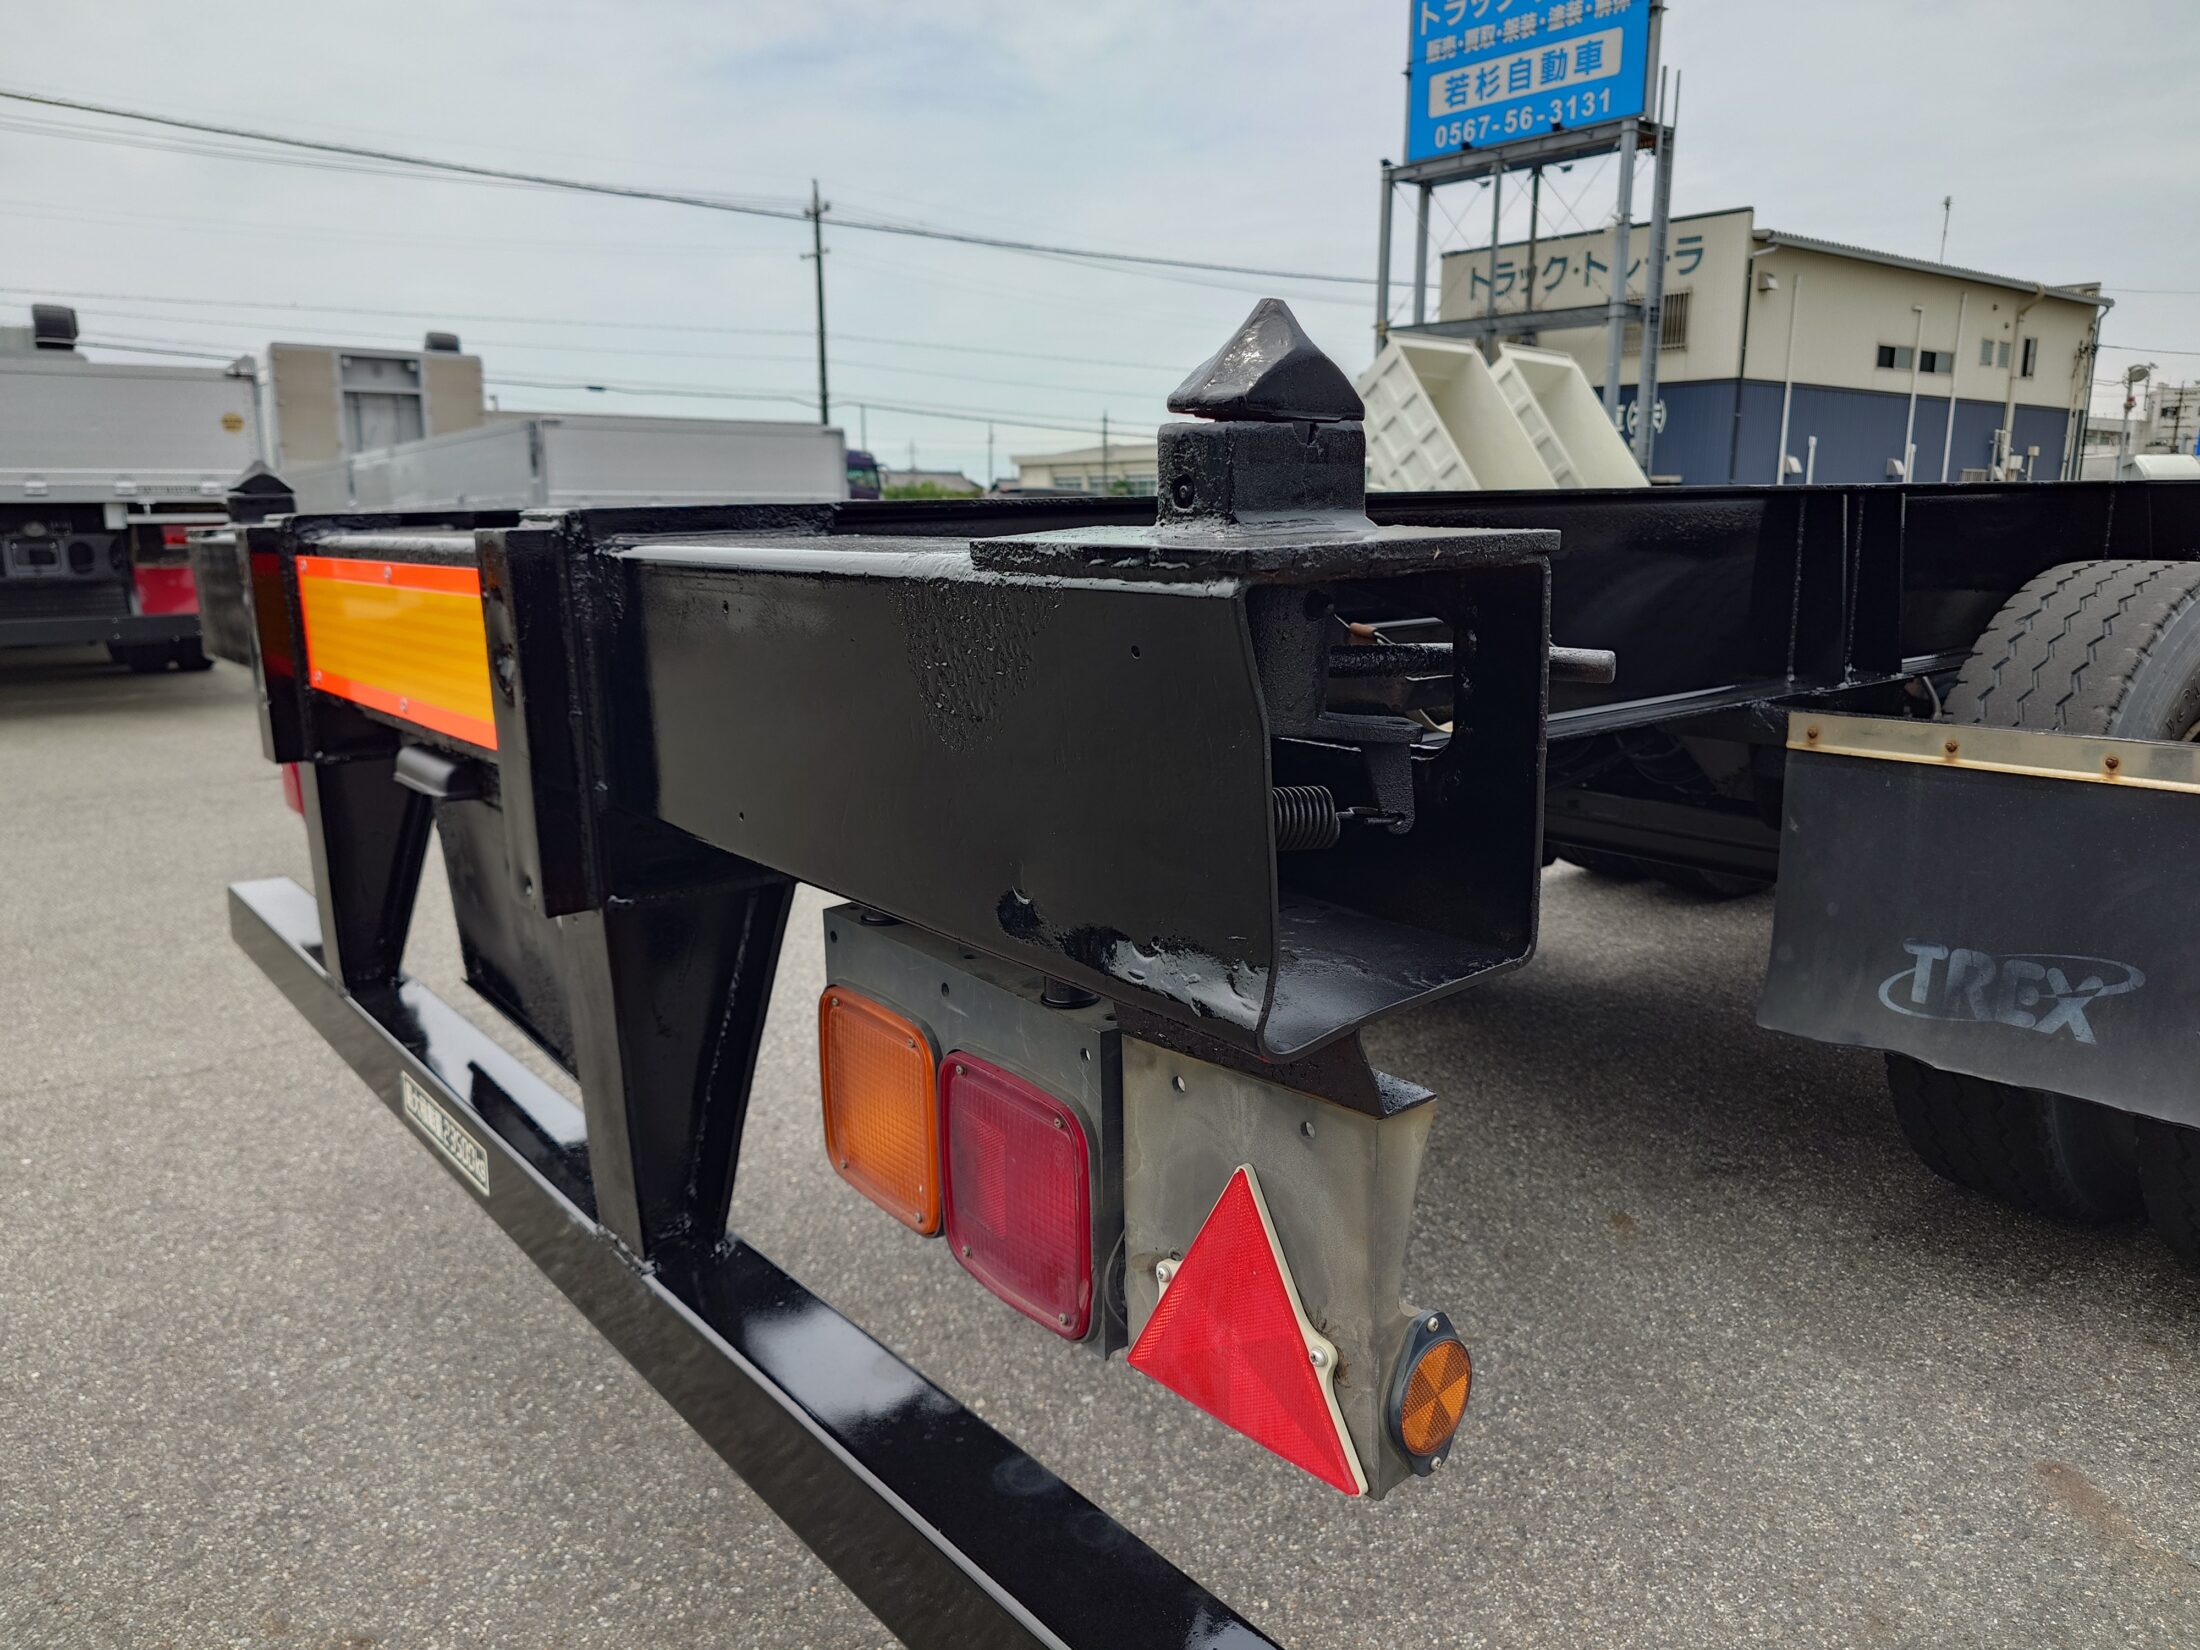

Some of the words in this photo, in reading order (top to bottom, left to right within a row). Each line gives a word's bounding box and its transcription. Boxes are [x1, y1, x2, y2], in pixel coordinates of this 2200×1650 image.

[1445, 40, 1604, 108] 若杉自動車
[1434, 88, 1611, 149] 0567-56-3131
[1902, 938, 2104, 1046] TREX
